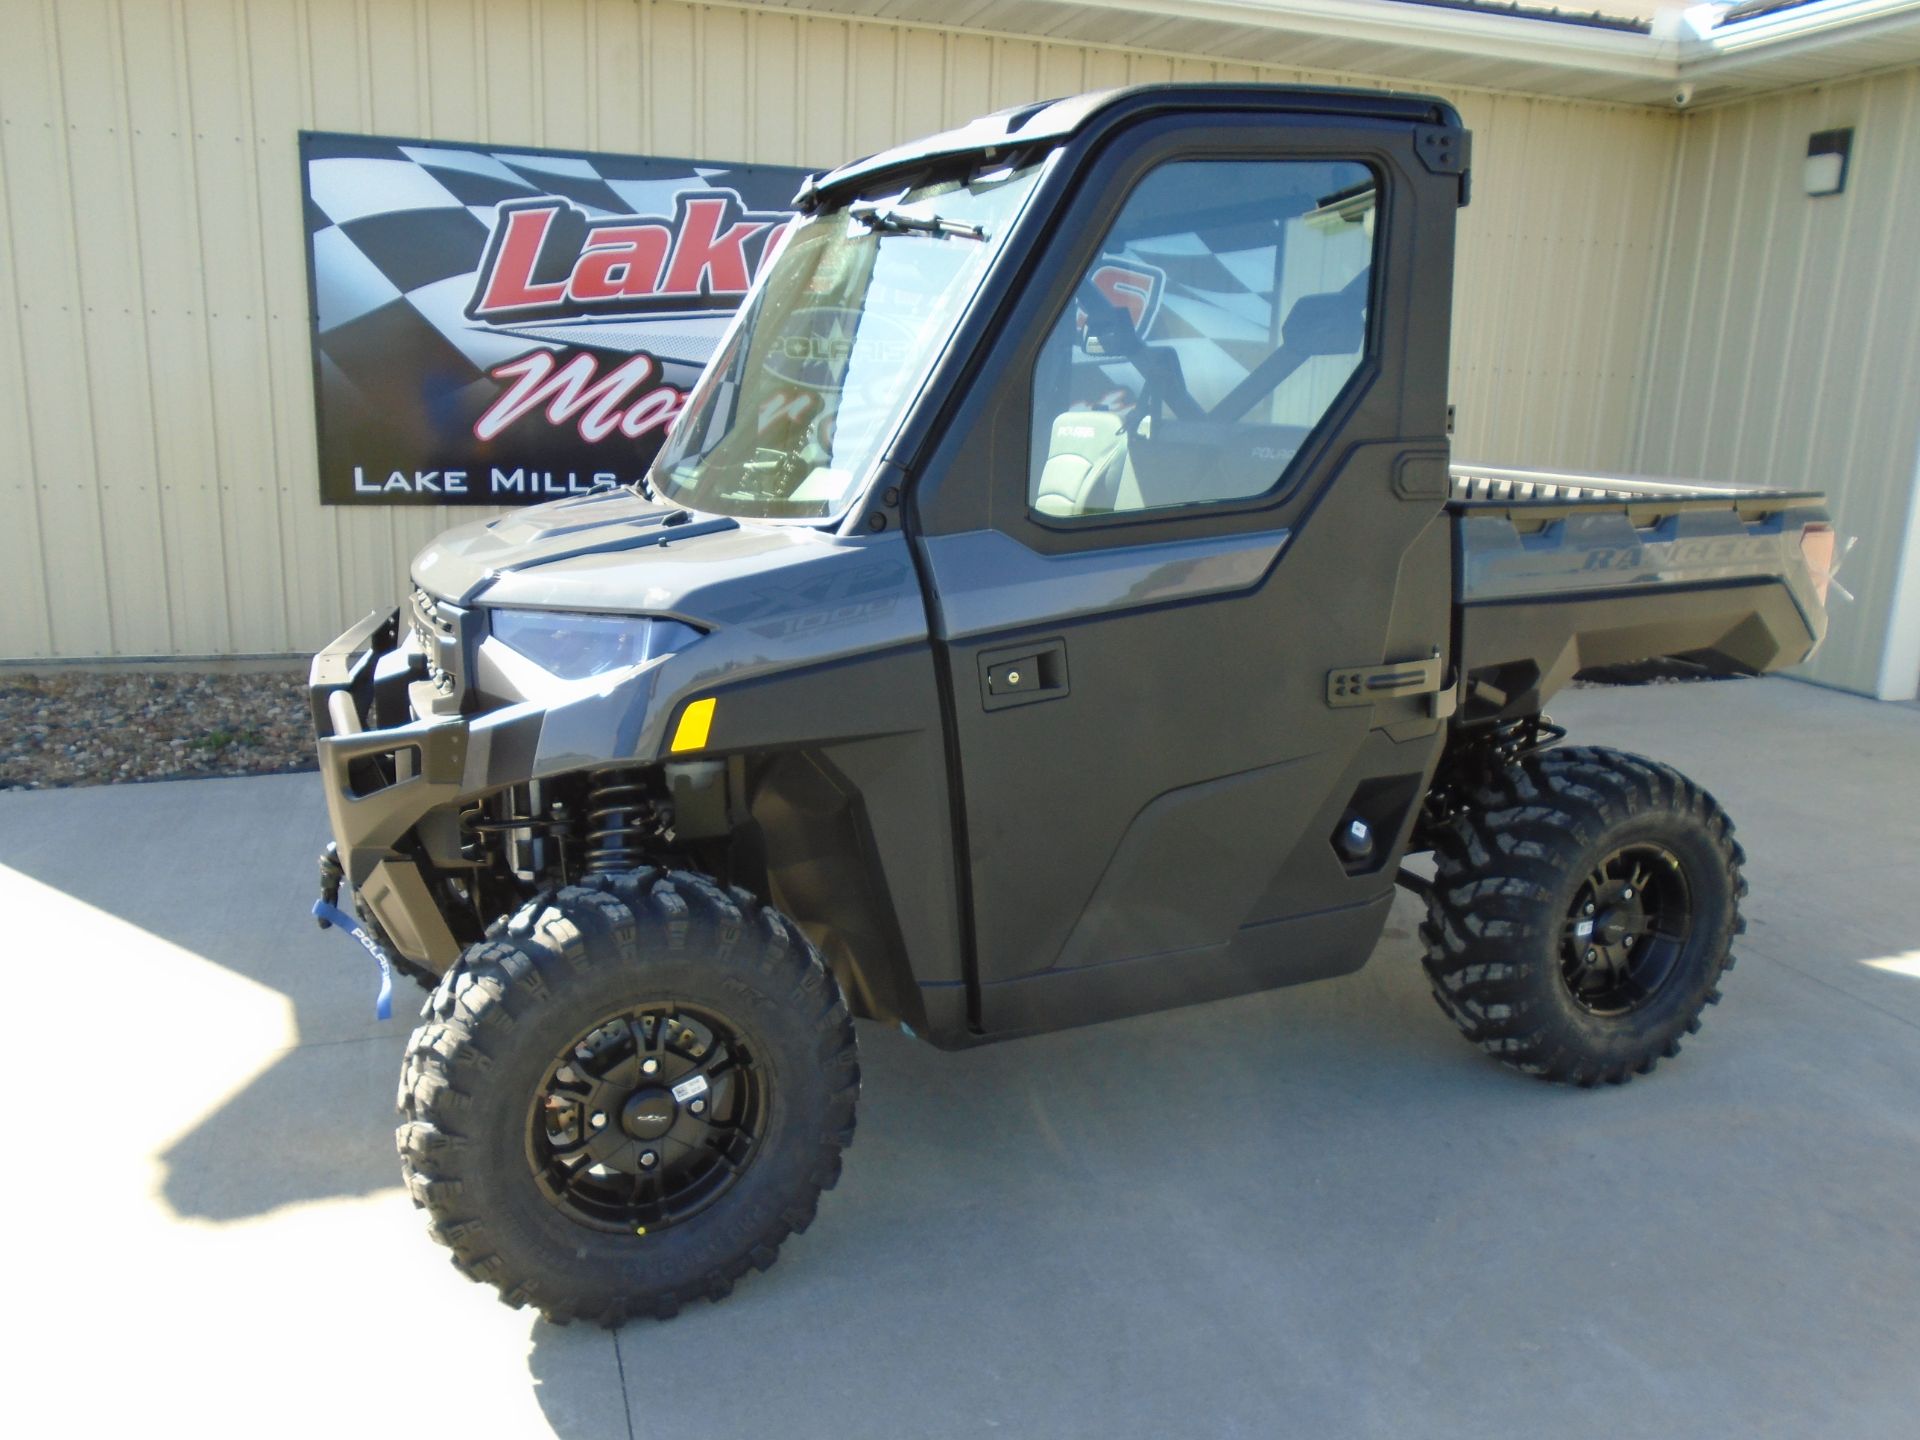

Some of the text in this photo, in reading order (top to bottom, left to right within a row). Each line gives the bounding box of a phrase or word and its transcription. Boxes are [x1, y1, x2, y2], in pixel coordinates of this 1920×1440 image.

[476, 198, 792, 313] Lak
[474, 351, 694, 443] Mo
[354, 466, 617, 492] LAKE MILLS
